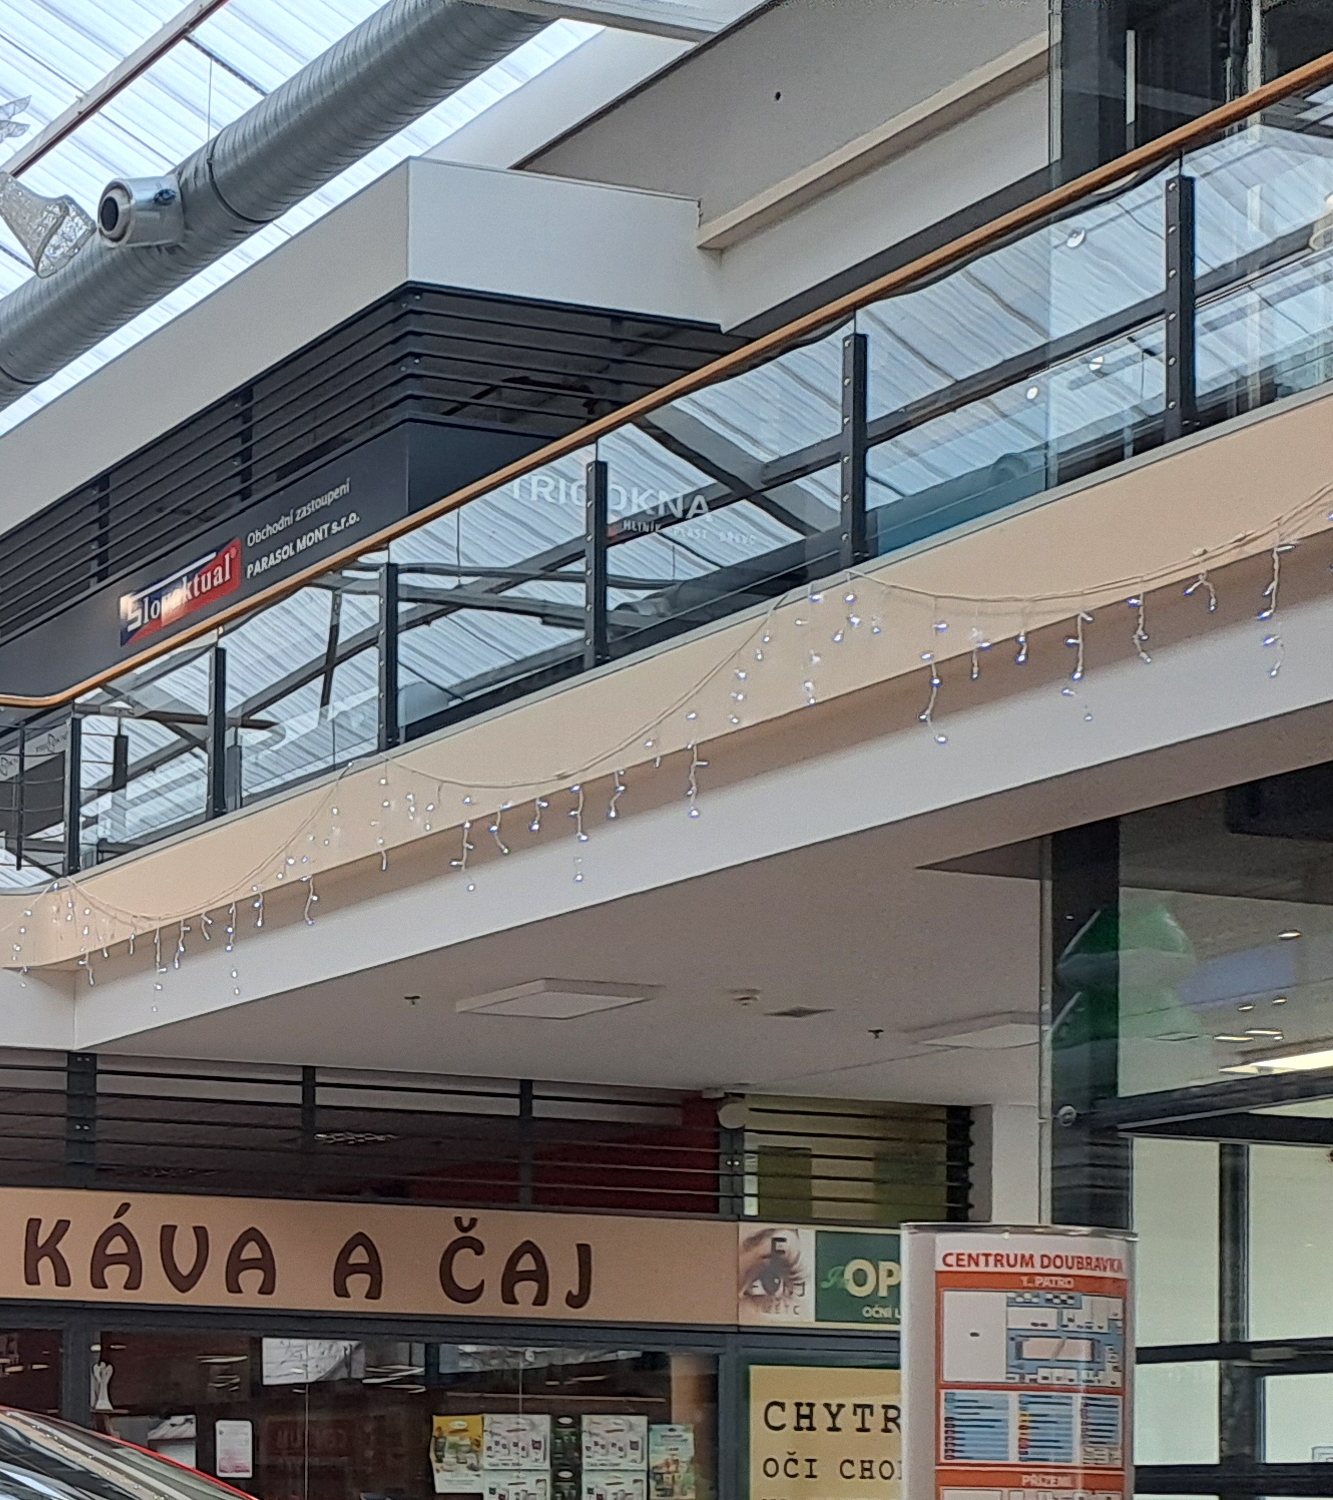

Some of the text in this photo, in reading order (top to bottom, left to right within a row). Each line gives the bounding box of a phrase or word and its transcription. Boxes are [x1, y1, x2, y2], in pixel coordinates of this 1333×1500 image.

[246, 512, 361, 579] PARASOL MONT s.r.o.
[247, 477, 351, 547] Obchodní zastoupení
[120, 553, 231, 632] Sloktual
[23, 1202, 593, 1309] KÁVA A ČAJ
[942, 1252, 1124, 1273] CENTRUM DOUBRAVKA
[764, 1401, 901, 1433] CHYTR
[763, 1451, 902, 1480] OČI CHO
